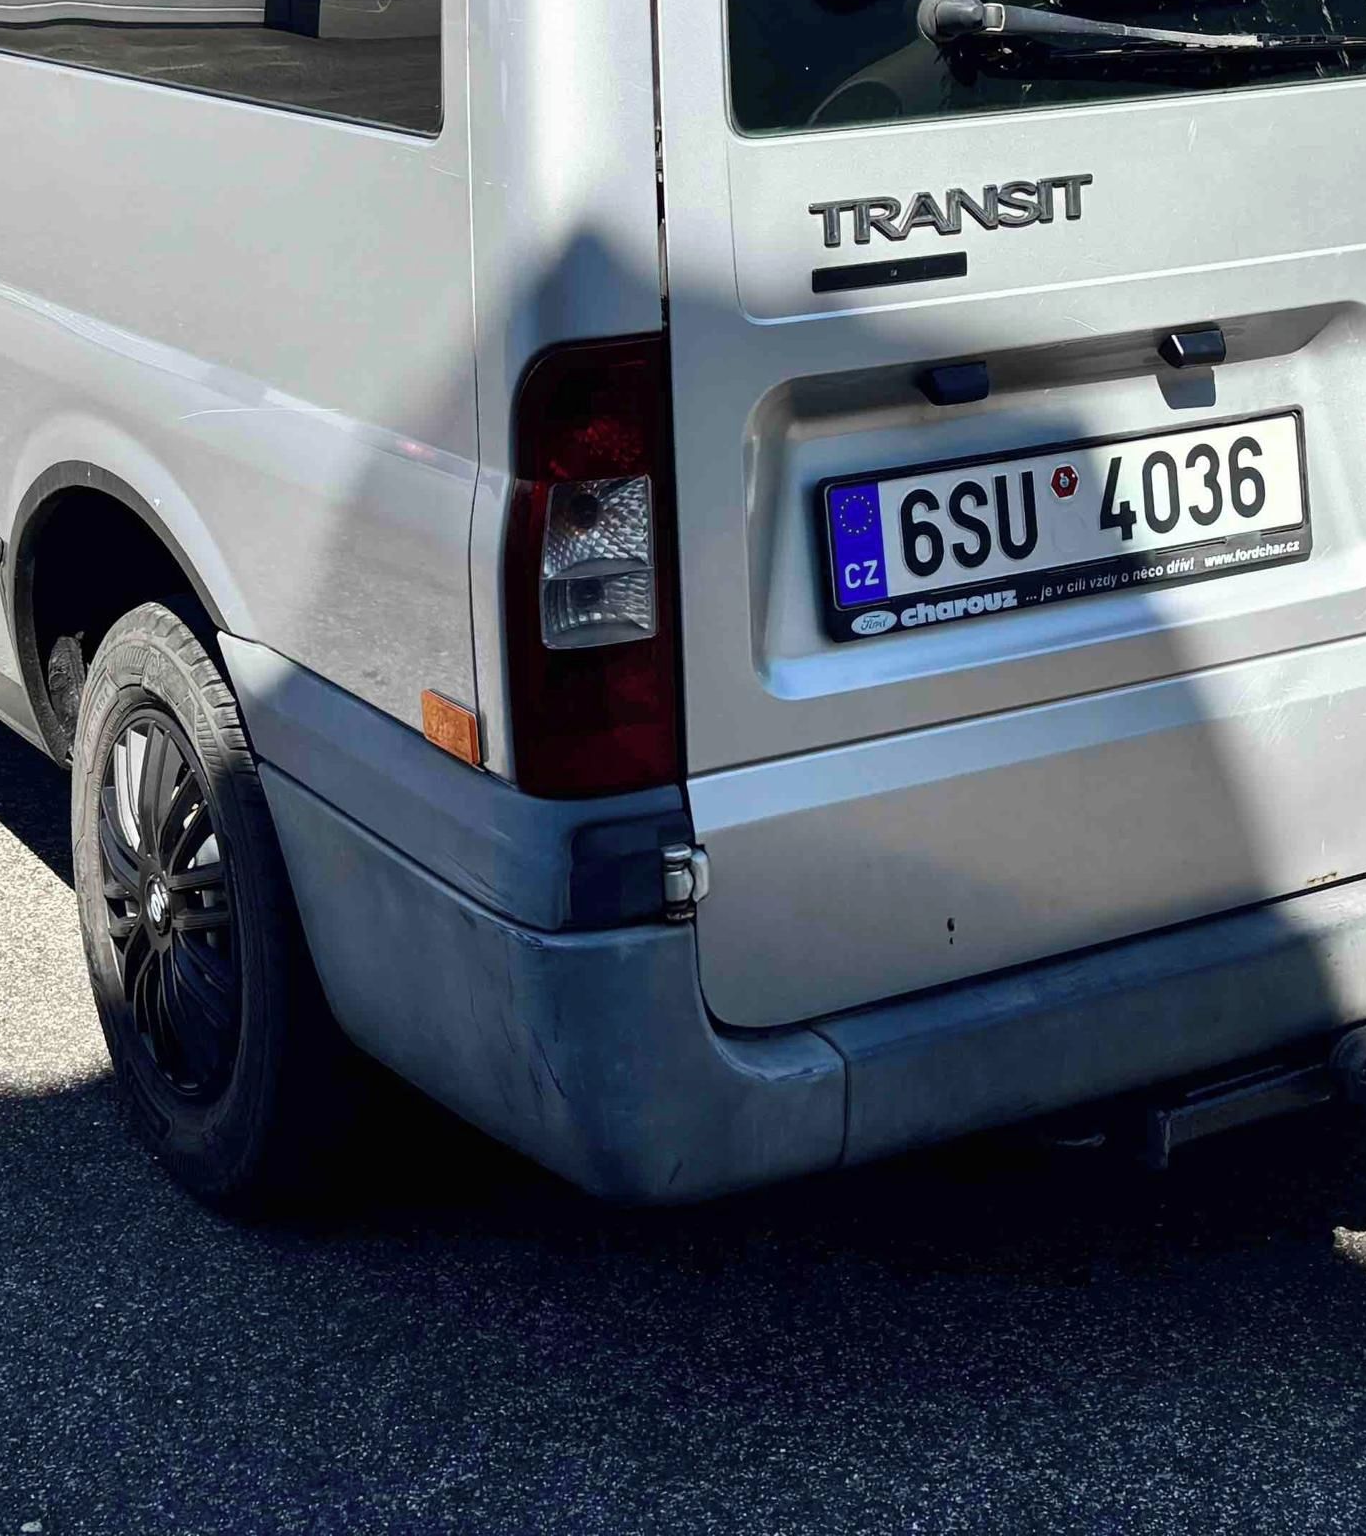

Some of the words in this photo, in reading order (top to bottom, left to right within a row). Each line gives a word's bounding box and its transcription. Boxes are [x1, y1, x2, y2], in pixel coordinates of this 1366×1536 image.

[808, 173, 1093, 248] TRANSIT
[899, 470, 1038, 577] 6SU
[1099, 436, 1266, 541] 4036
[1203, 540, 1300, 568] www.fordchar.cz
[844, 560, 880, 589] CZ
[1040, 584, 1053, 602] je
[1121, 572, 1129, 583] o
[900, 590, 1018, 627] charouz
